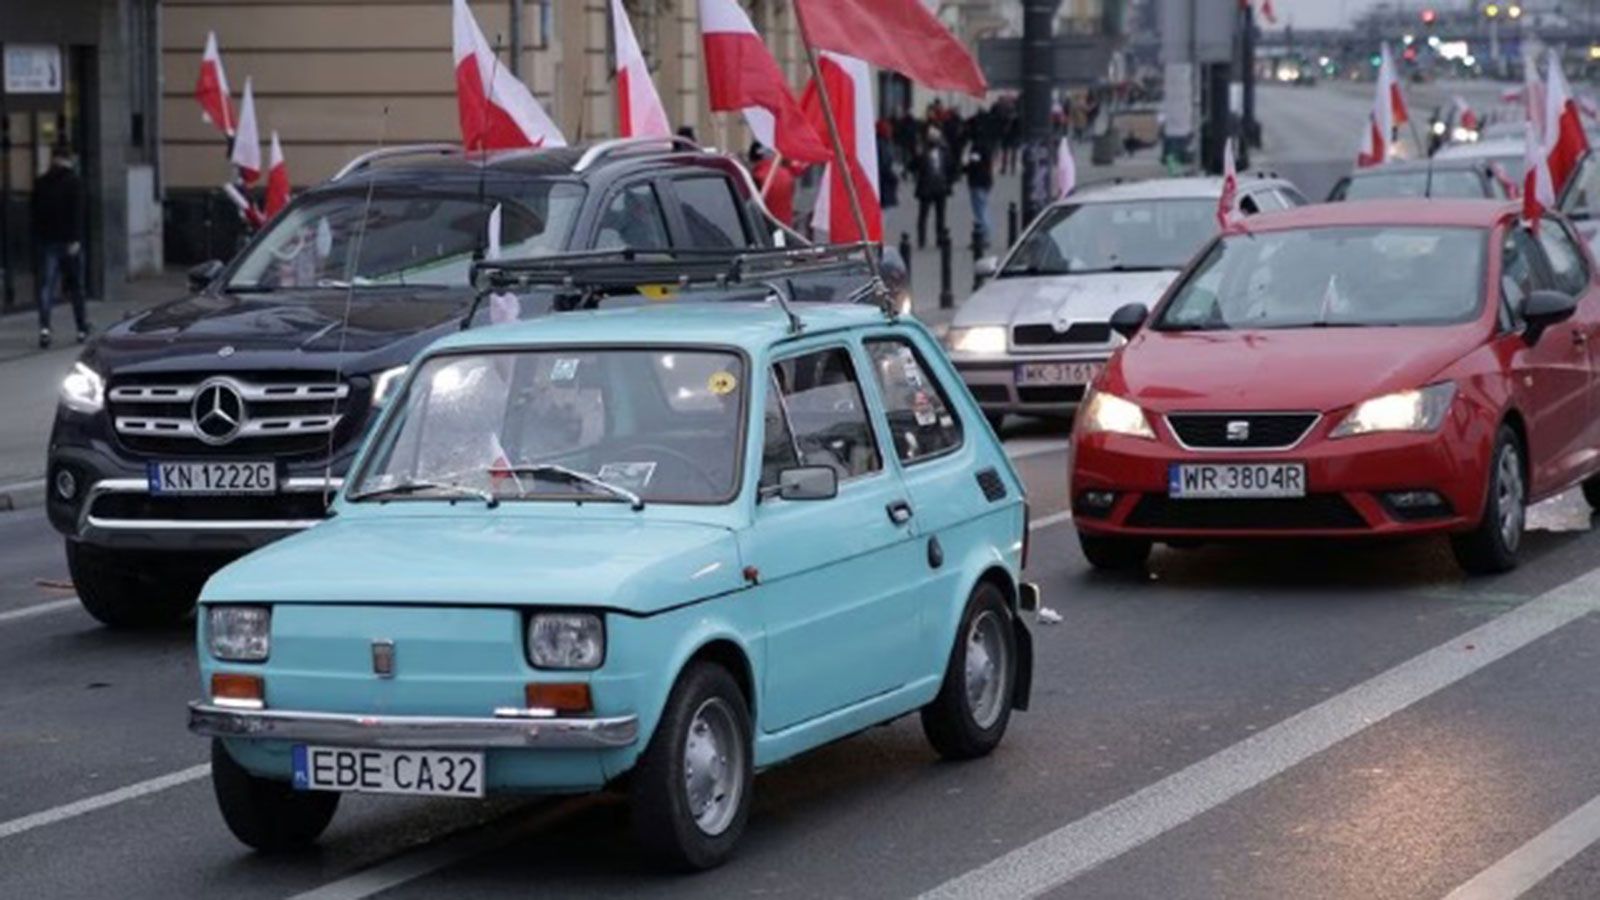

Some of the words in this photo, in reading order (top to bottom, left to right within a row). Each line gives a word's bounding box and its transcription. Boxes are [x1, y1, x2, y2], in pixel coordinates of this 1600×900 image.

[163, 464, 192, 488] KN
[202, 464, 271, 488] 1222G
[1184, 466, 1218, 490] WR
[1227, 466, 1301, 490] 3804R
[313, 751, 382, 788] EBE
[394, 754, 477, 792] CA32
